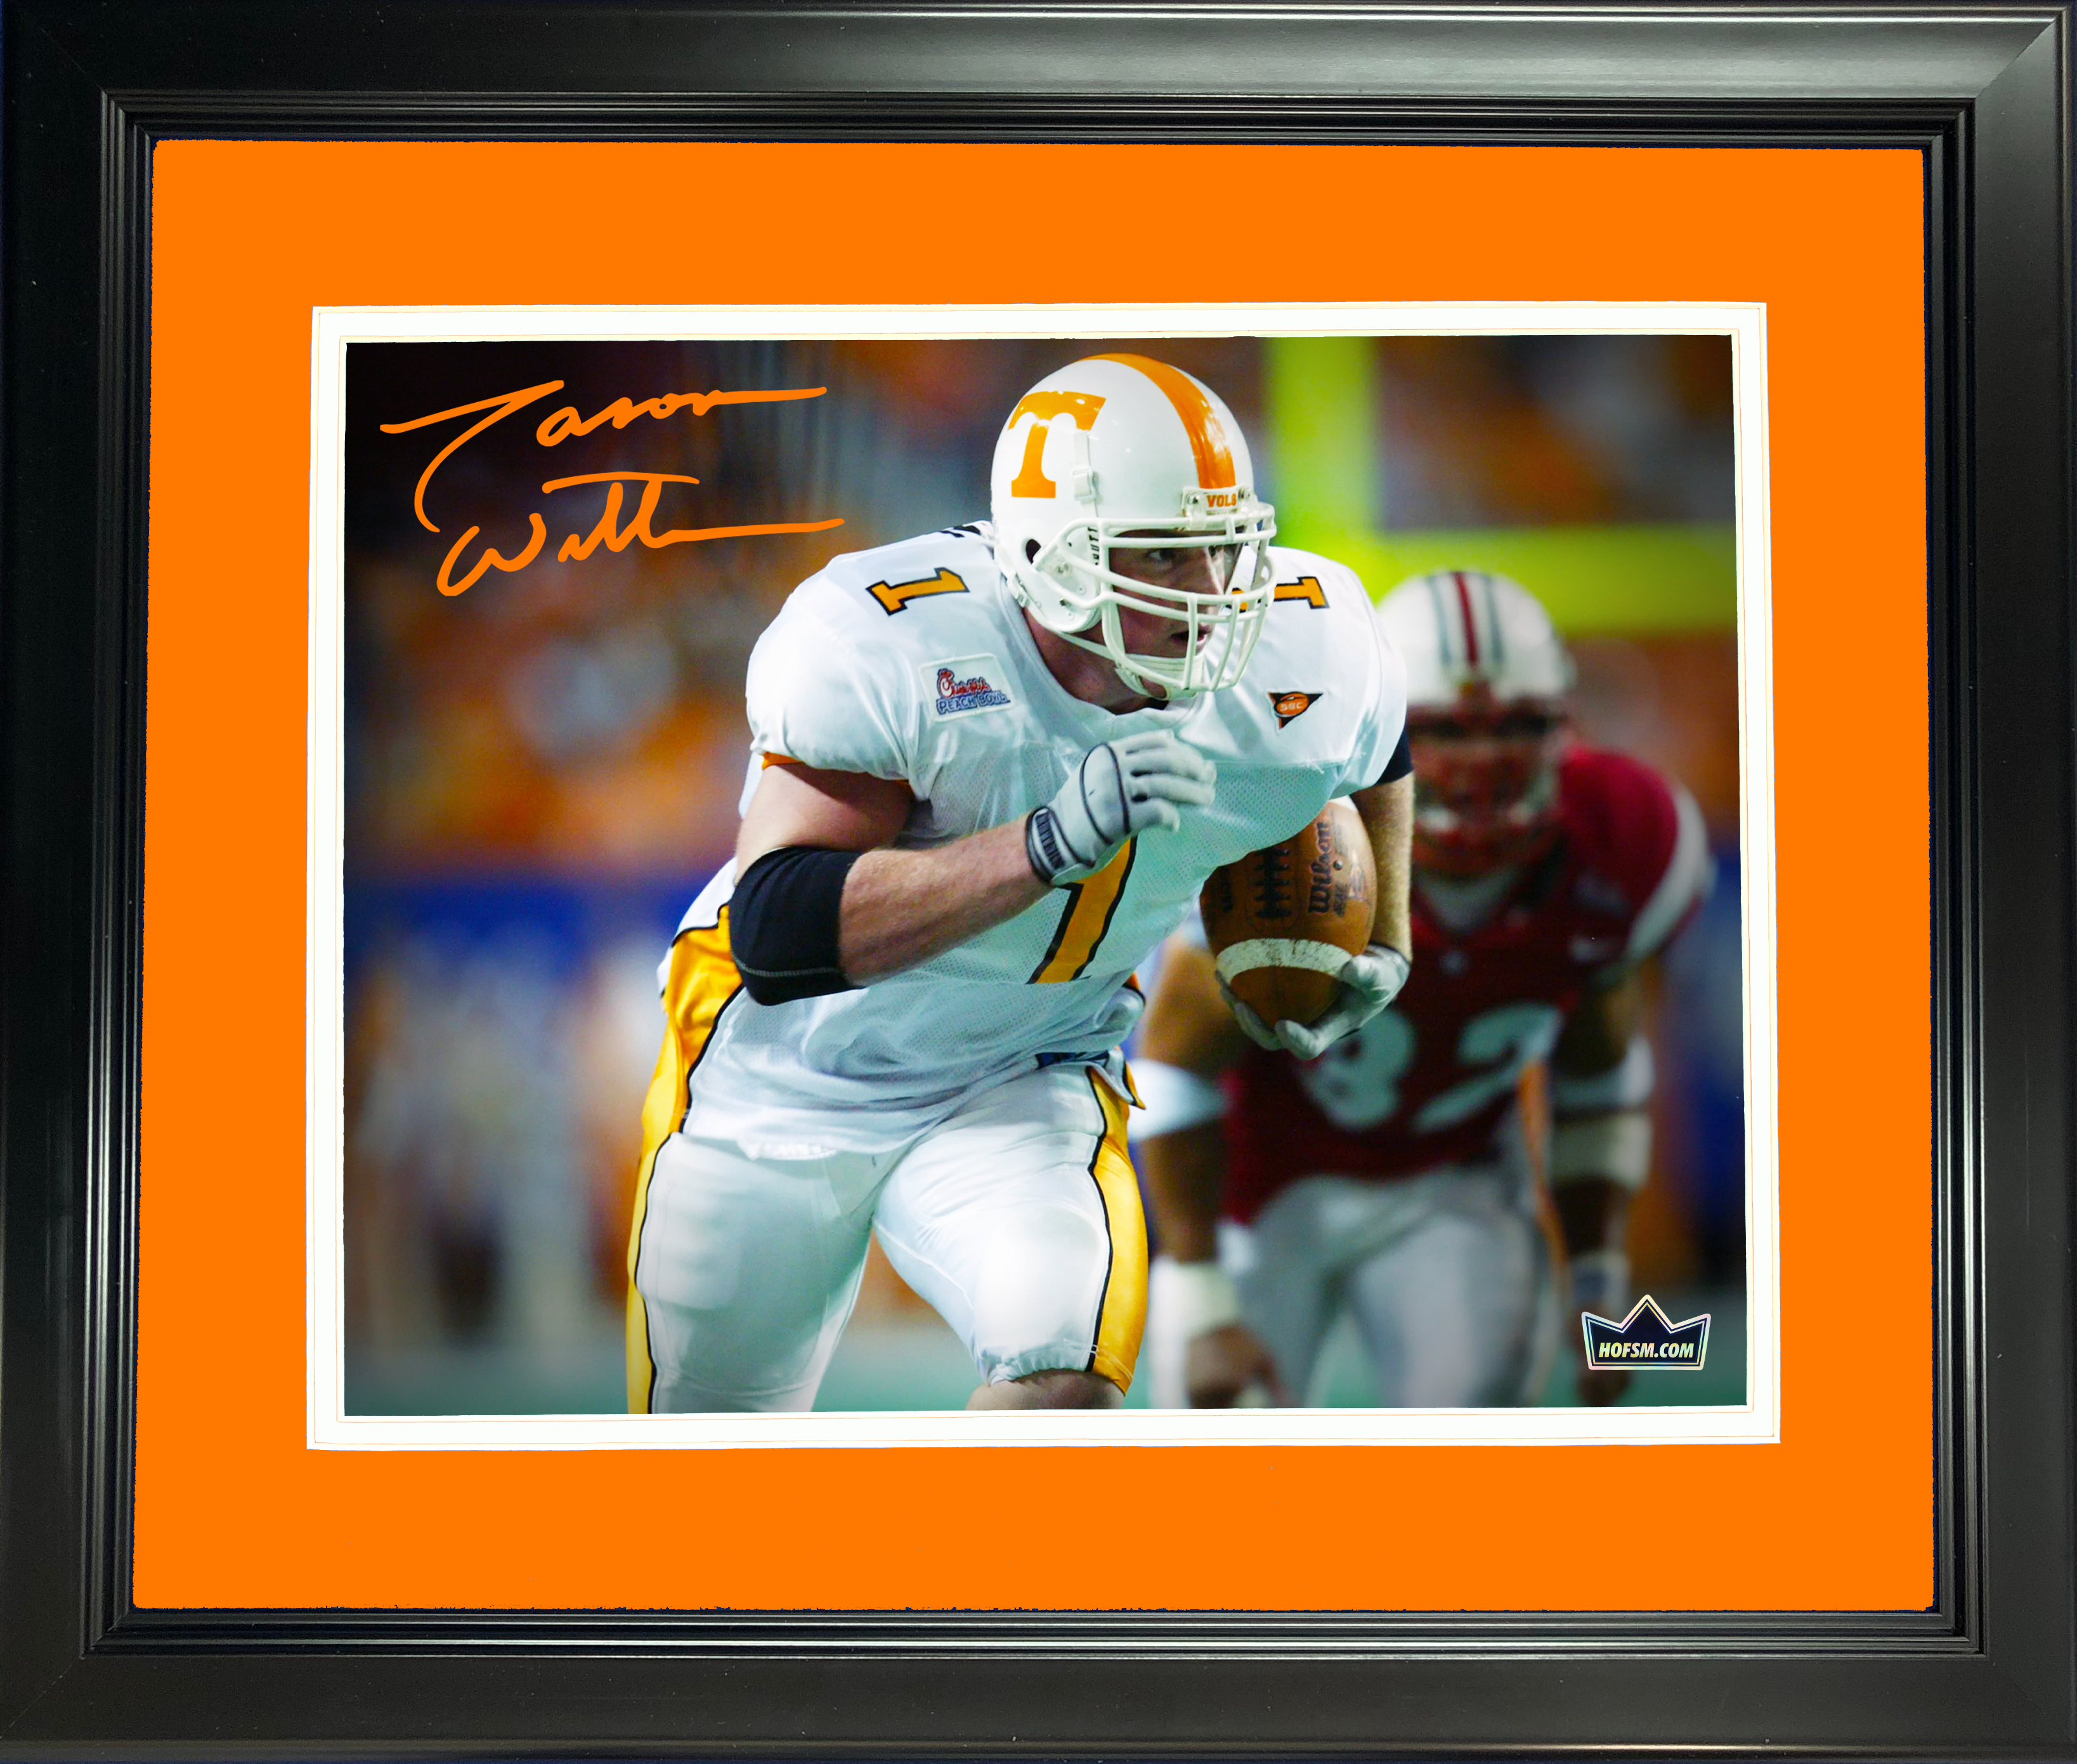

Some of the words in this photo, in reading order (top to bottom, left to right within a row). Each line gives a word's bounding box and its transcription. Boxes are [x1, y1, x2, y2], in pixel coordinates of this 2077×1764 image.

[1008, 391, 1107, 499] T
[1206, 493, 1237, 507] VOLS
[865, 566, 970, 617] 1
[937, 695, 977, 715] PEACH
[977, 690, 1010, 707] BOWL
[1308, 821, 1331, 913] Wilson
[1598, 1342, 1695, 1359] HOFSM.COM
